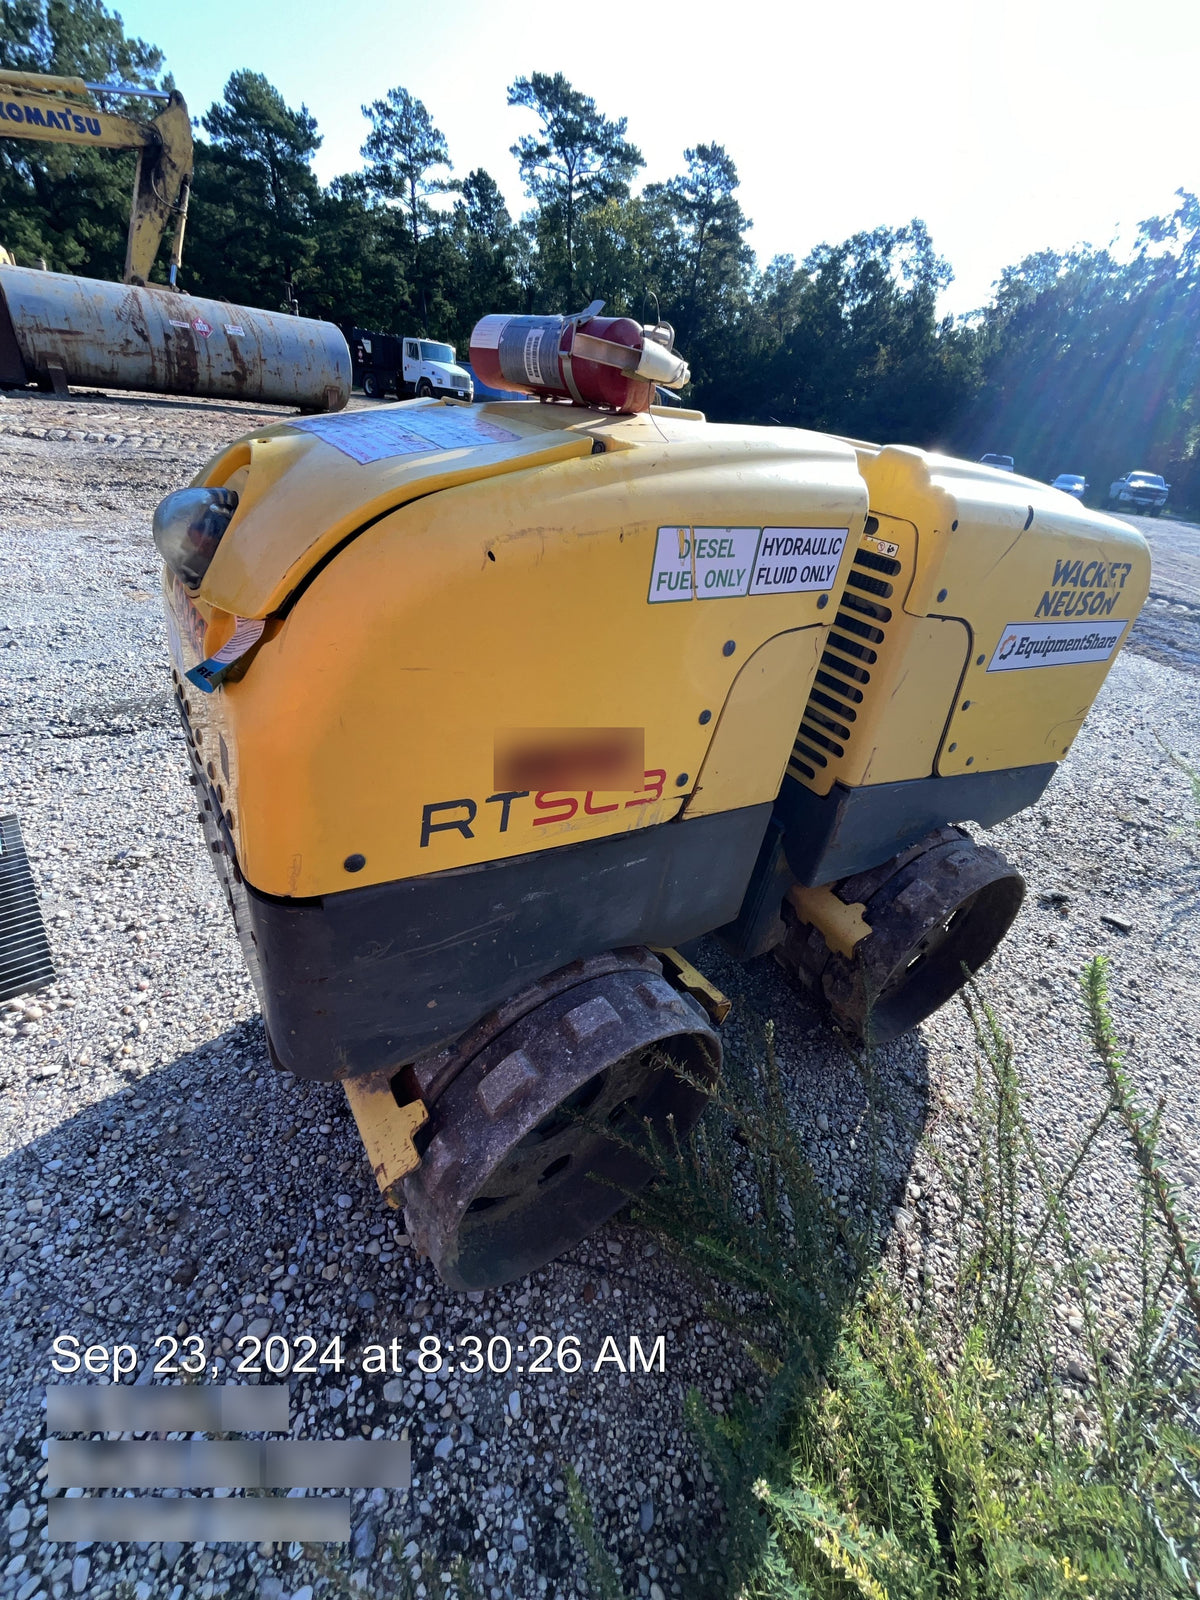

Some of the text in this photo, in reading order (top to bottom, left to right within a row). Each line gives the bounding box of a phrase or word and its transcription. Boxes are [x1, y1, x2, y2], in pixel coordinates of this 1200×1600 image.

[678, 538, 735, 559] DIESEL
[762, 537, 842, 557] HYDRAULIC
[656, 568, 746, 591] FUEL ONLY
[756, 565, 835, 585] FLUID ONLY
[1051, 559, 1132, 588] WACKER
[1034, 590, 1120, 618] NEUSON
[1015, 633, 1117, 658] EquipmentShare
